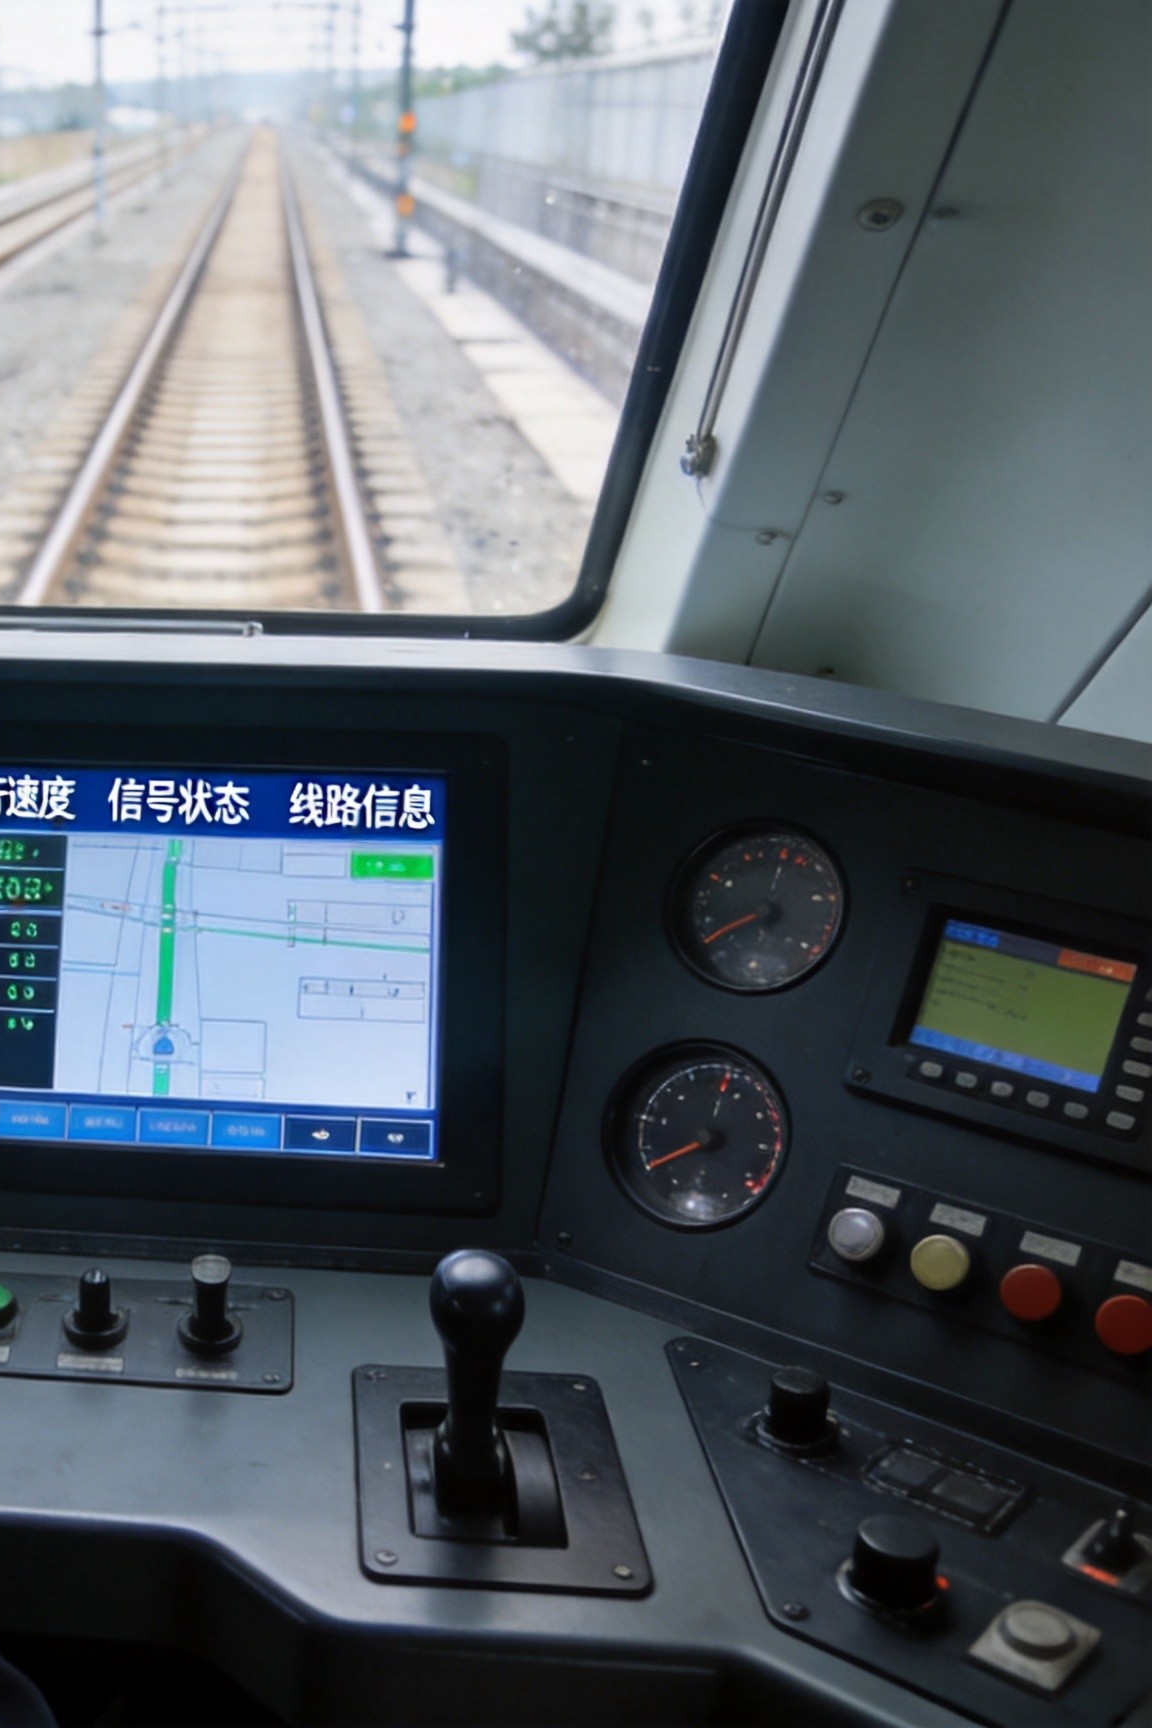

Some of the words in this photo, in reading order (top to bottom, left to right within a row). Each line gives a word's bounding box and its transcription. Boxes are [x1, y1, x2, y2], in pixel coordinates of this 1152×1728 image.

[107, 777, 250, 825] 信号状态
[288, 782, 436, 830] 线路信息
